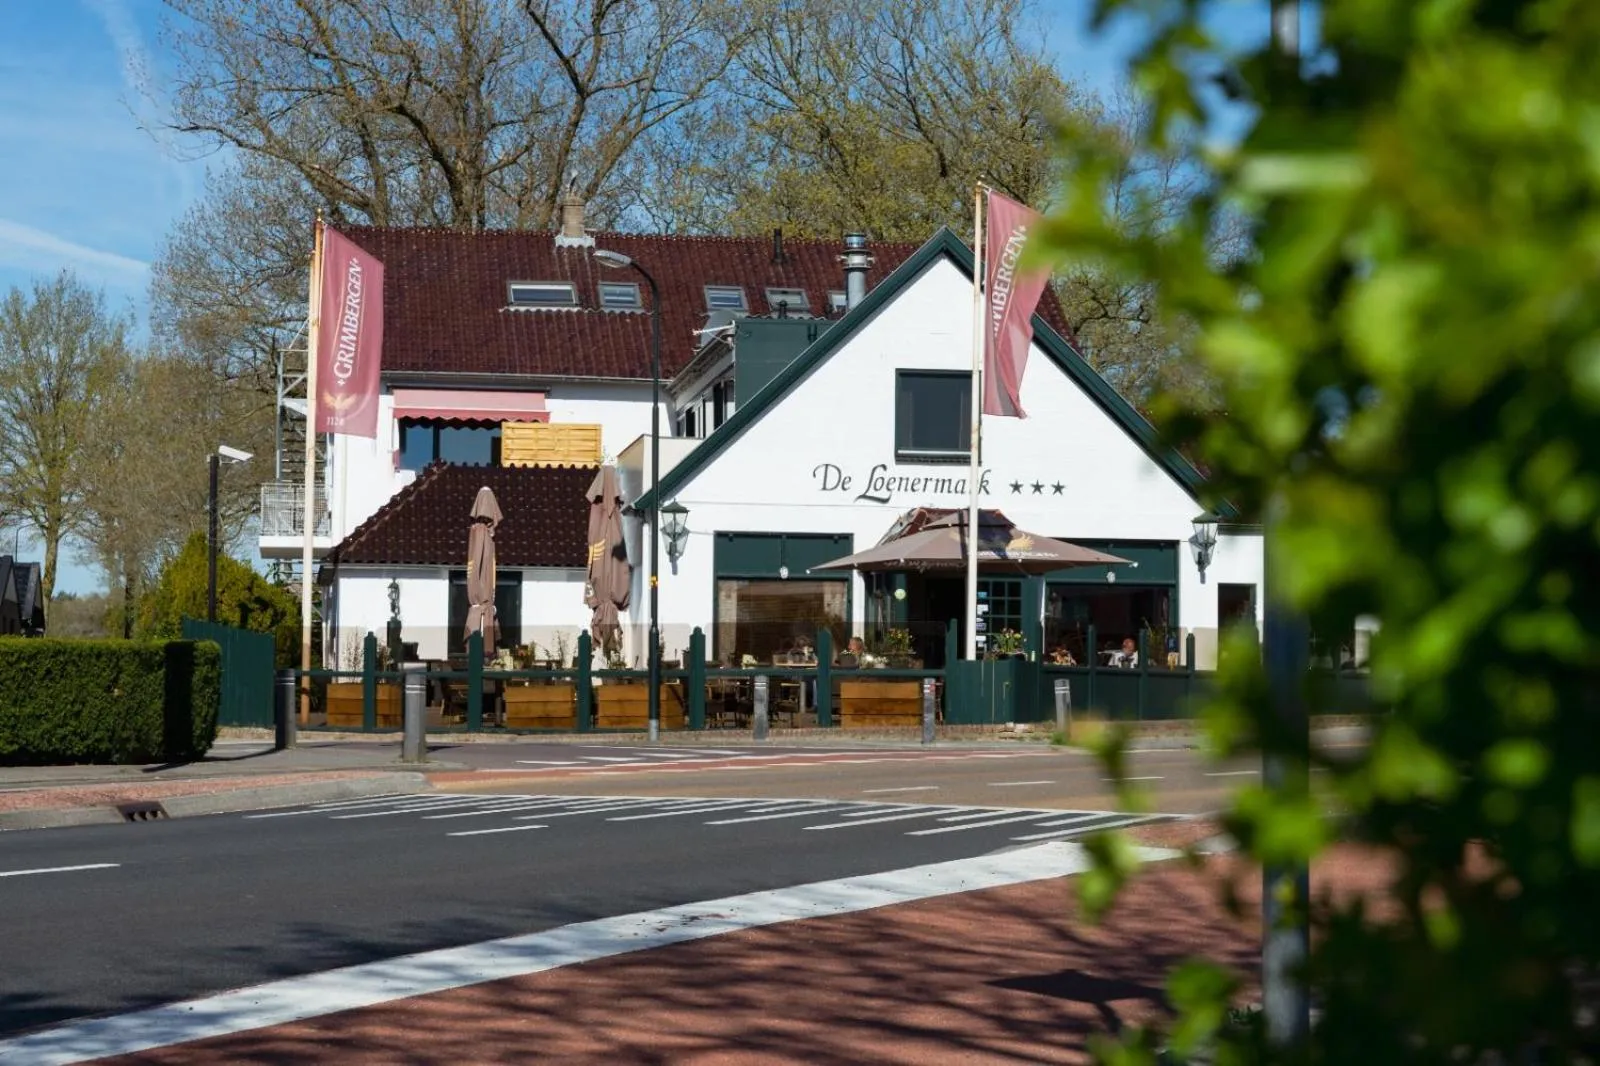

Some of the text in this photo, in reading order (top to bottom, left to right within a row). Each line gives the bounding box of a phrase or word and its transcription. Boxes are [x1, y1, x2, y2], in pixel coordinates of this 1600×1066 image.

[333, 262, 364, 379] GRIMBERGEN
[812, 463, 992, 503] De Loenermak
